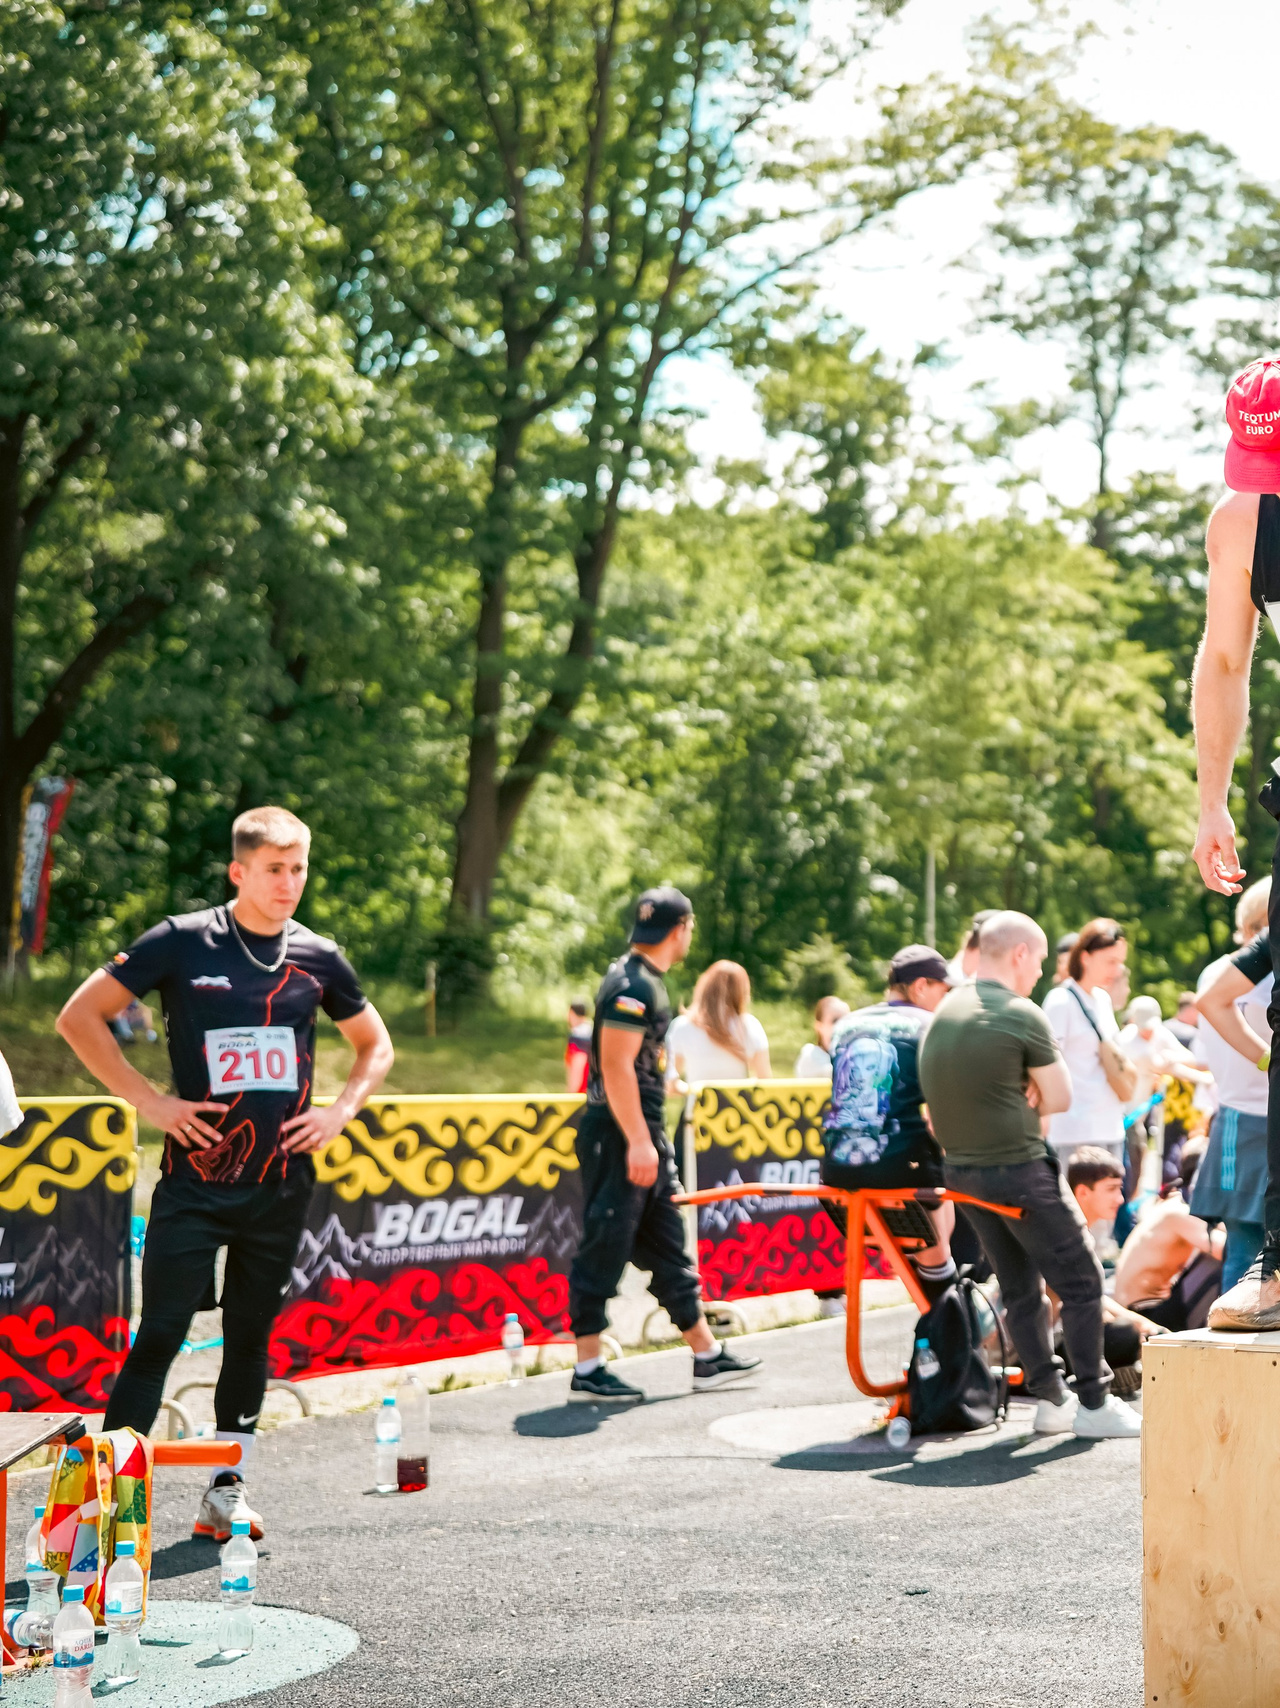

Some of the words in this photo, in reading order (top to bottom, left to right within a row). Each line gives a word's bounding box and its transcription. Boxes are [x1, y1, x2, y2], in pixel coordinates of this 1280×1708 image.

[1246, 425, 1274, 435] EURO
[219, 1047, 287, 1082] 210
[373, 1196, 529, 1247] BOGAL
